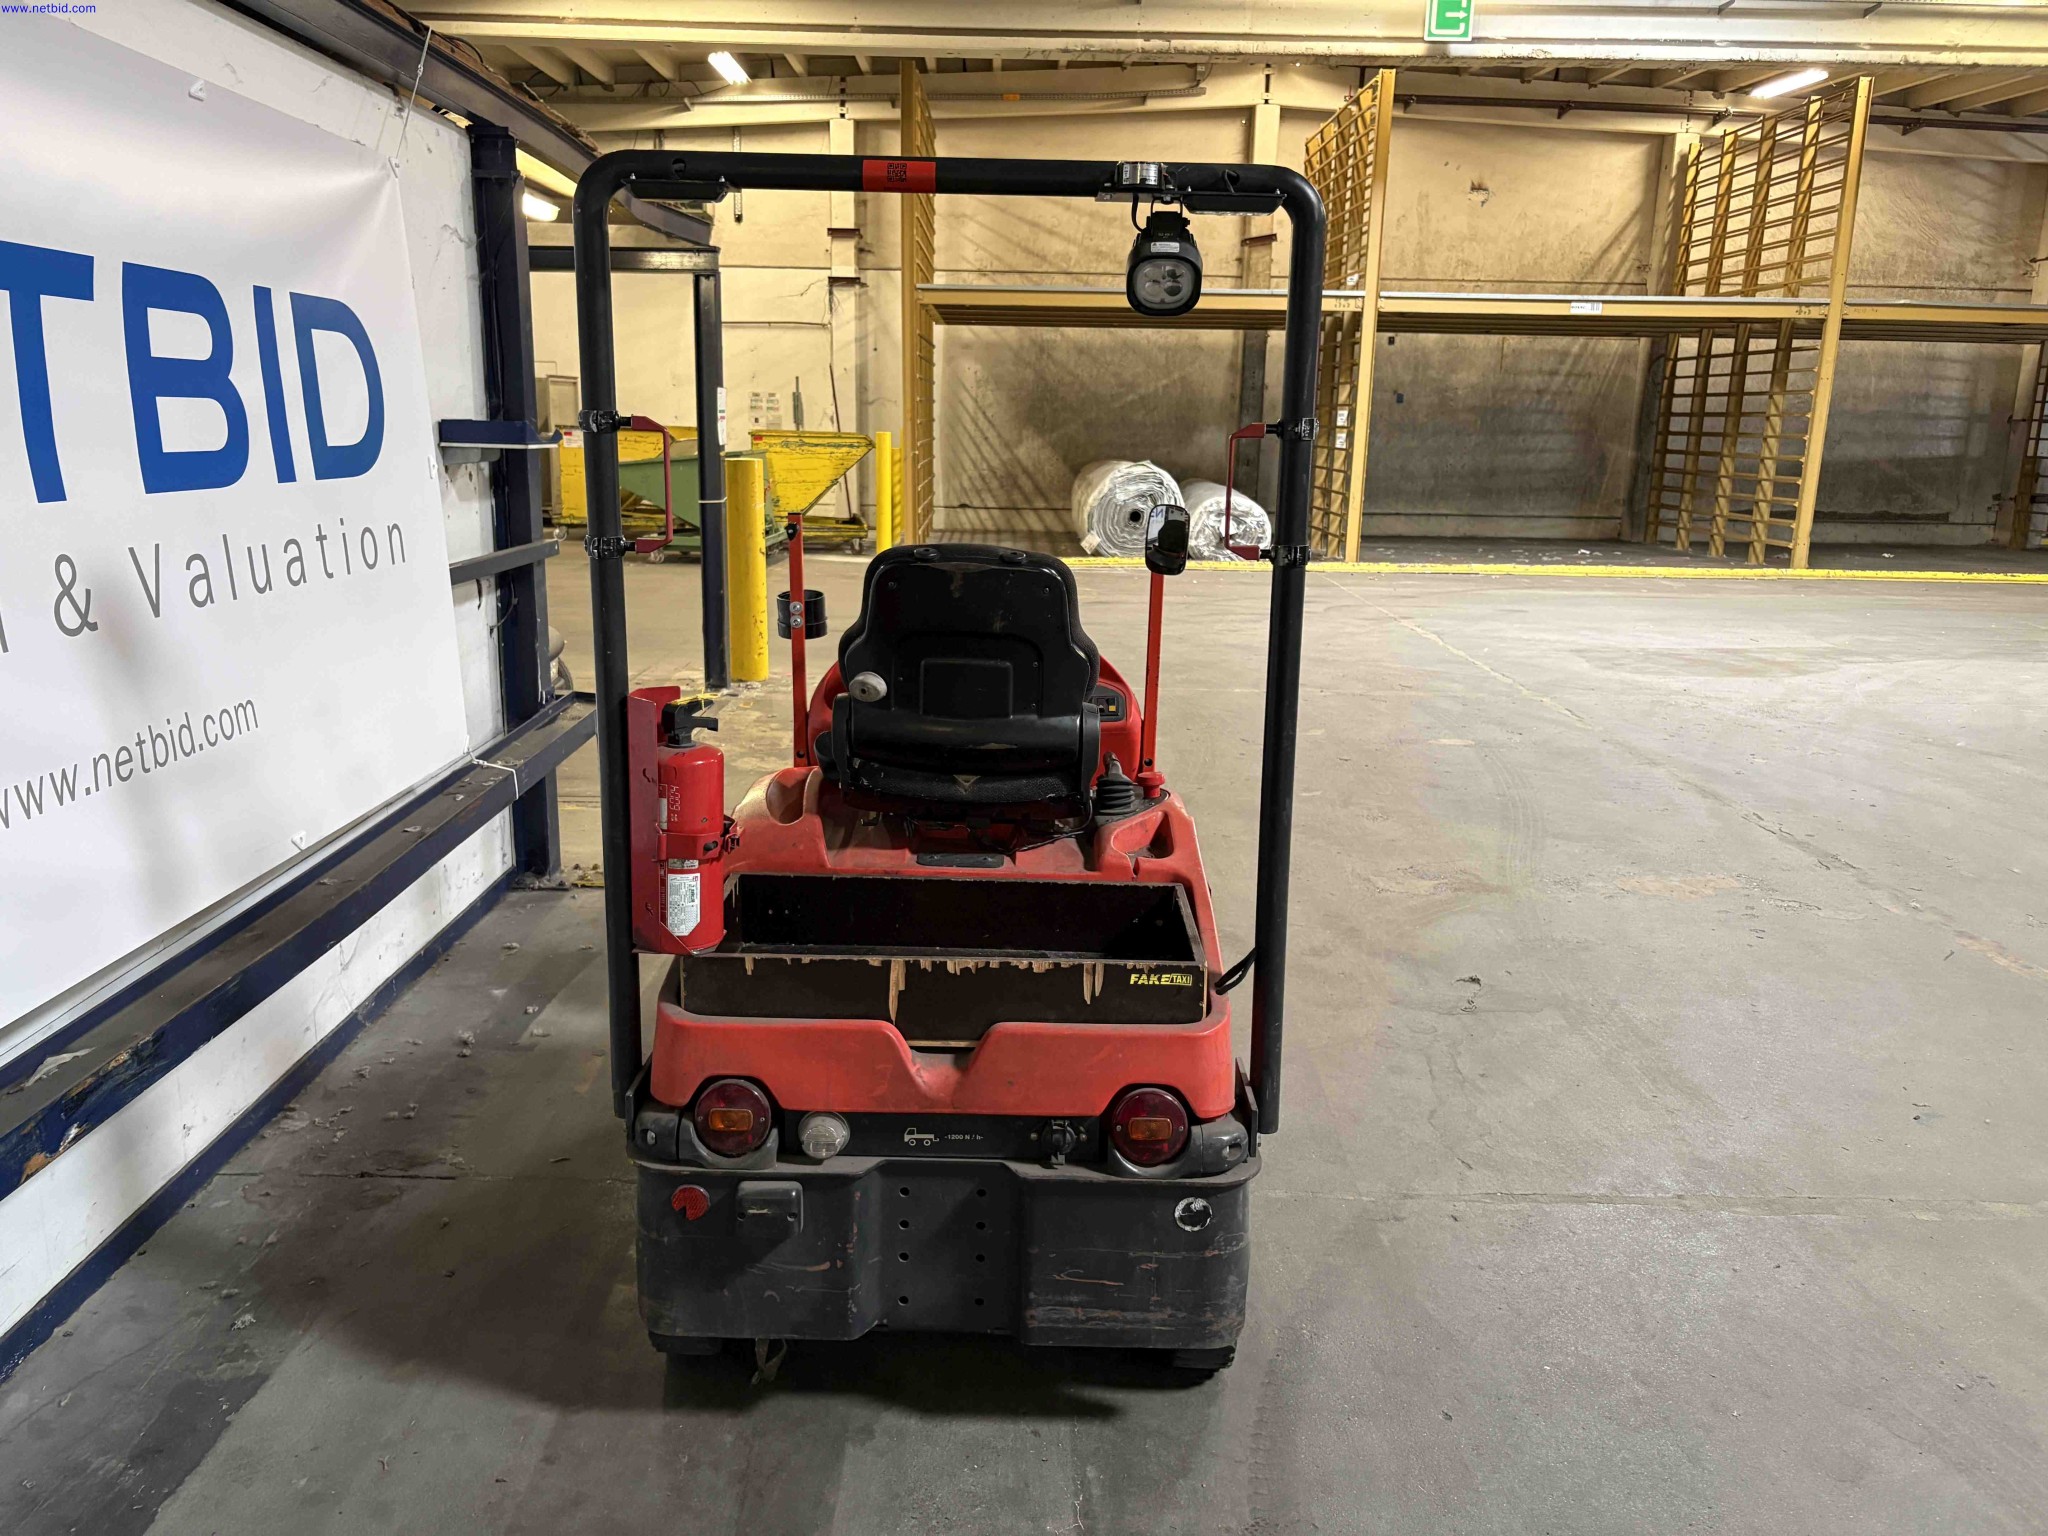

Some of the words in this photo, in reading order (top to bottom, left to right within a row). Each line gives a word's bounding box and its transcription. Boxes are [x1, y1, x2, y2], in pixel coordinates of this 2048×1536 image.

[53, 553, 99, 637] &
[128, 517, 407, 619] Valuation
[1129, 973, 1171, 985] FAKE
[1171, 974, 1191, 985] TAXI
